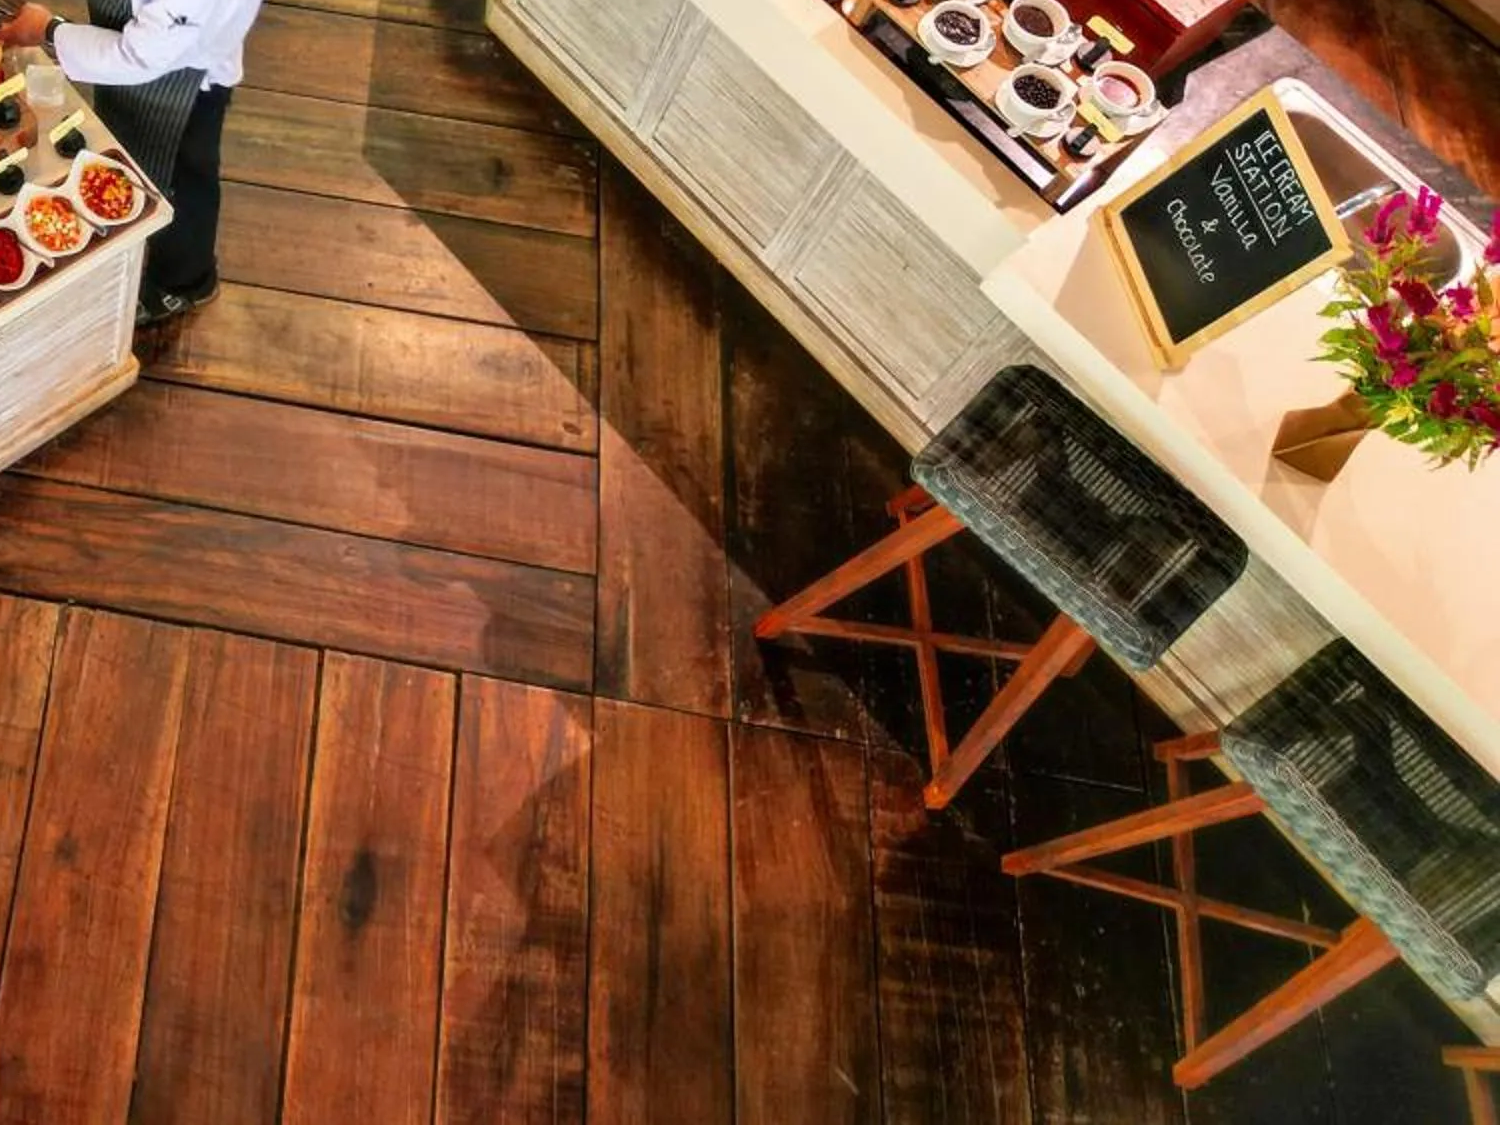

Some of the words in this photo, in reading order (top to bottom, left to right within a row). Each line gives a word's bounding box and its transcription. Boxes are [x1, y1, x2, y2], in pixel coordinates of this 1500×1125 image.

[1234, 141, 1293, 239] STATION
[1254, 130, 1283, 163] ICE
[1269, 158, 1315, 225] CREAM
[1167, 198, 1215, 283] Chocolate
[1200, 217, 1219, 235] &
